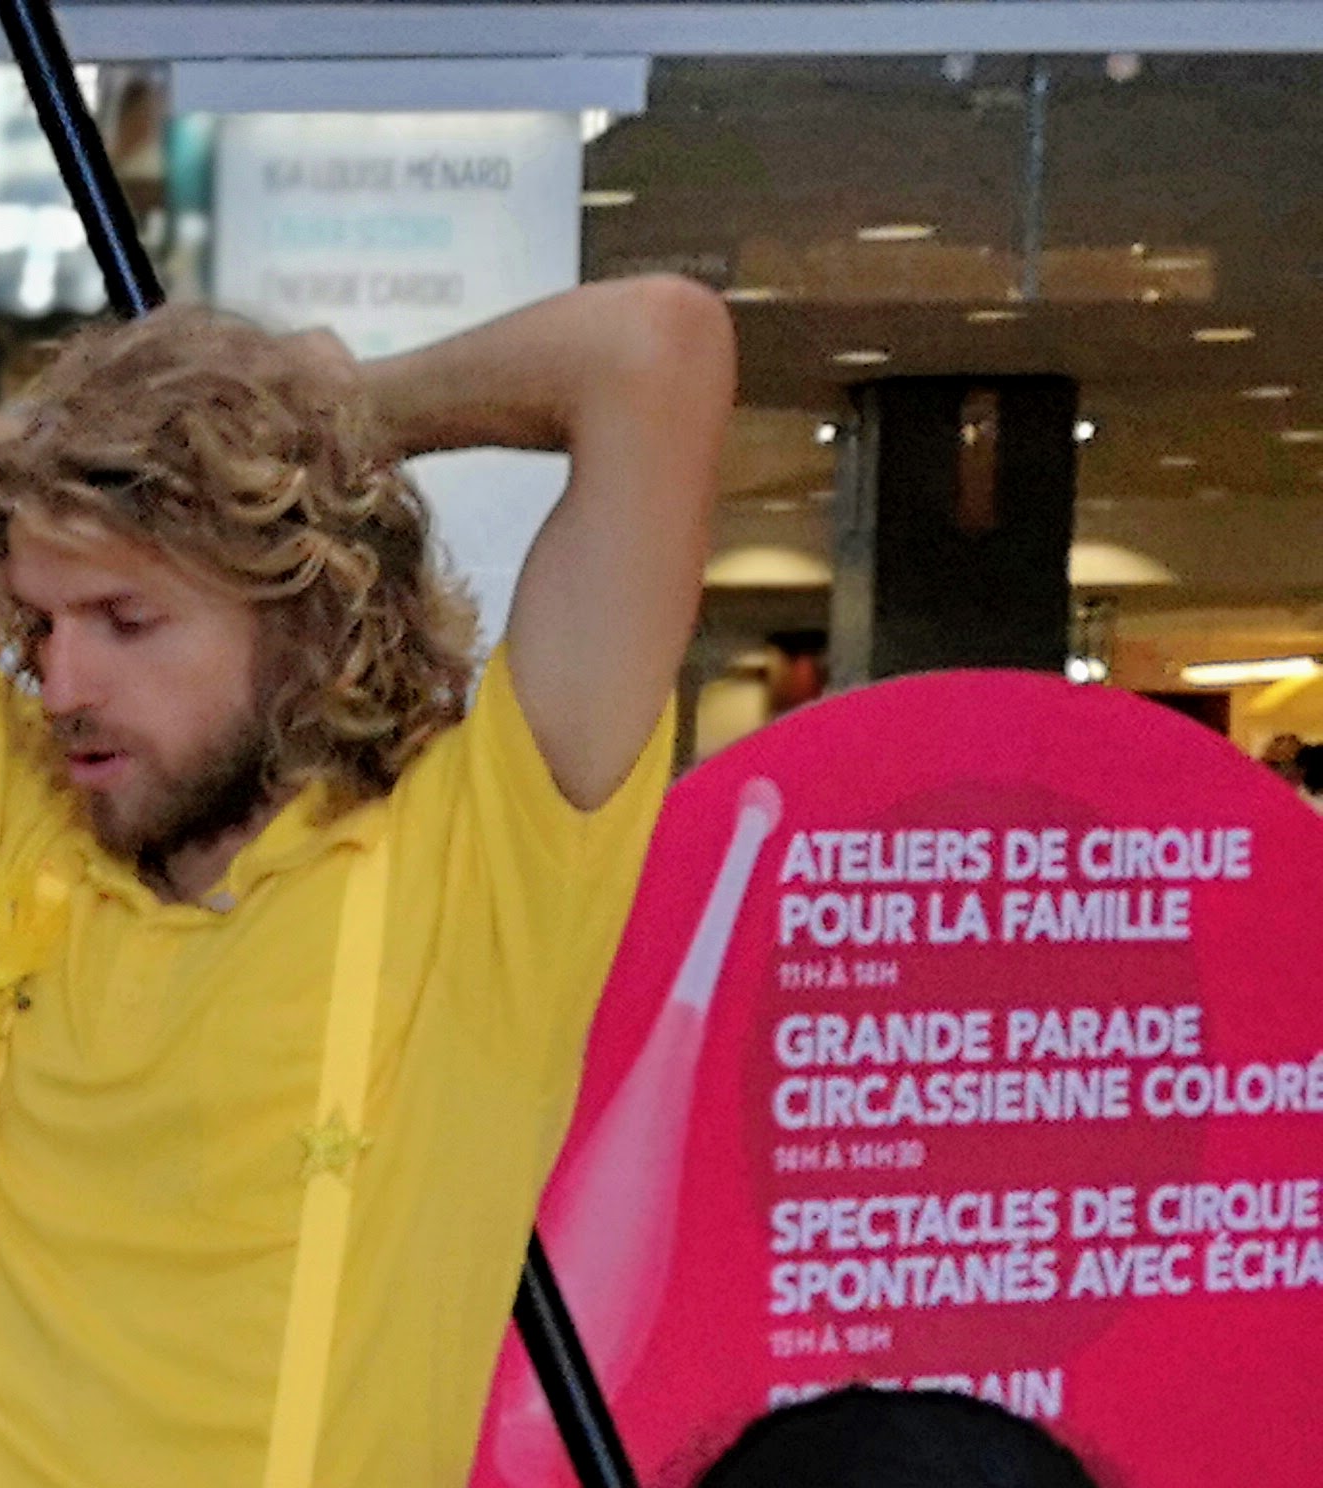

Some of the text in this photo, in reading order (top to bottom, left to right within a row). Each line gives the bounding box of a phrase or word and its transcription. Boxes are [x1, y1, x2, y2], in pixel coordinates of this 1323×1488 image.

[779, 826, 1253, 884] ATELIERS DE CIRQUE
[779, 888, 1191, 947] POUR LA FAMILLE
[774, 1004, 1203, 1067] GRANDE PARADE
[773, 1064, 1130, 1130] CIRCASSIENNE
[770, 1179, 1320, 1254] SPECTACLES DE CIRQUE
[769, 1239, 1059, 1315] SPONTANÉS
[1068, 1243, 1192, 1297] AVEC
